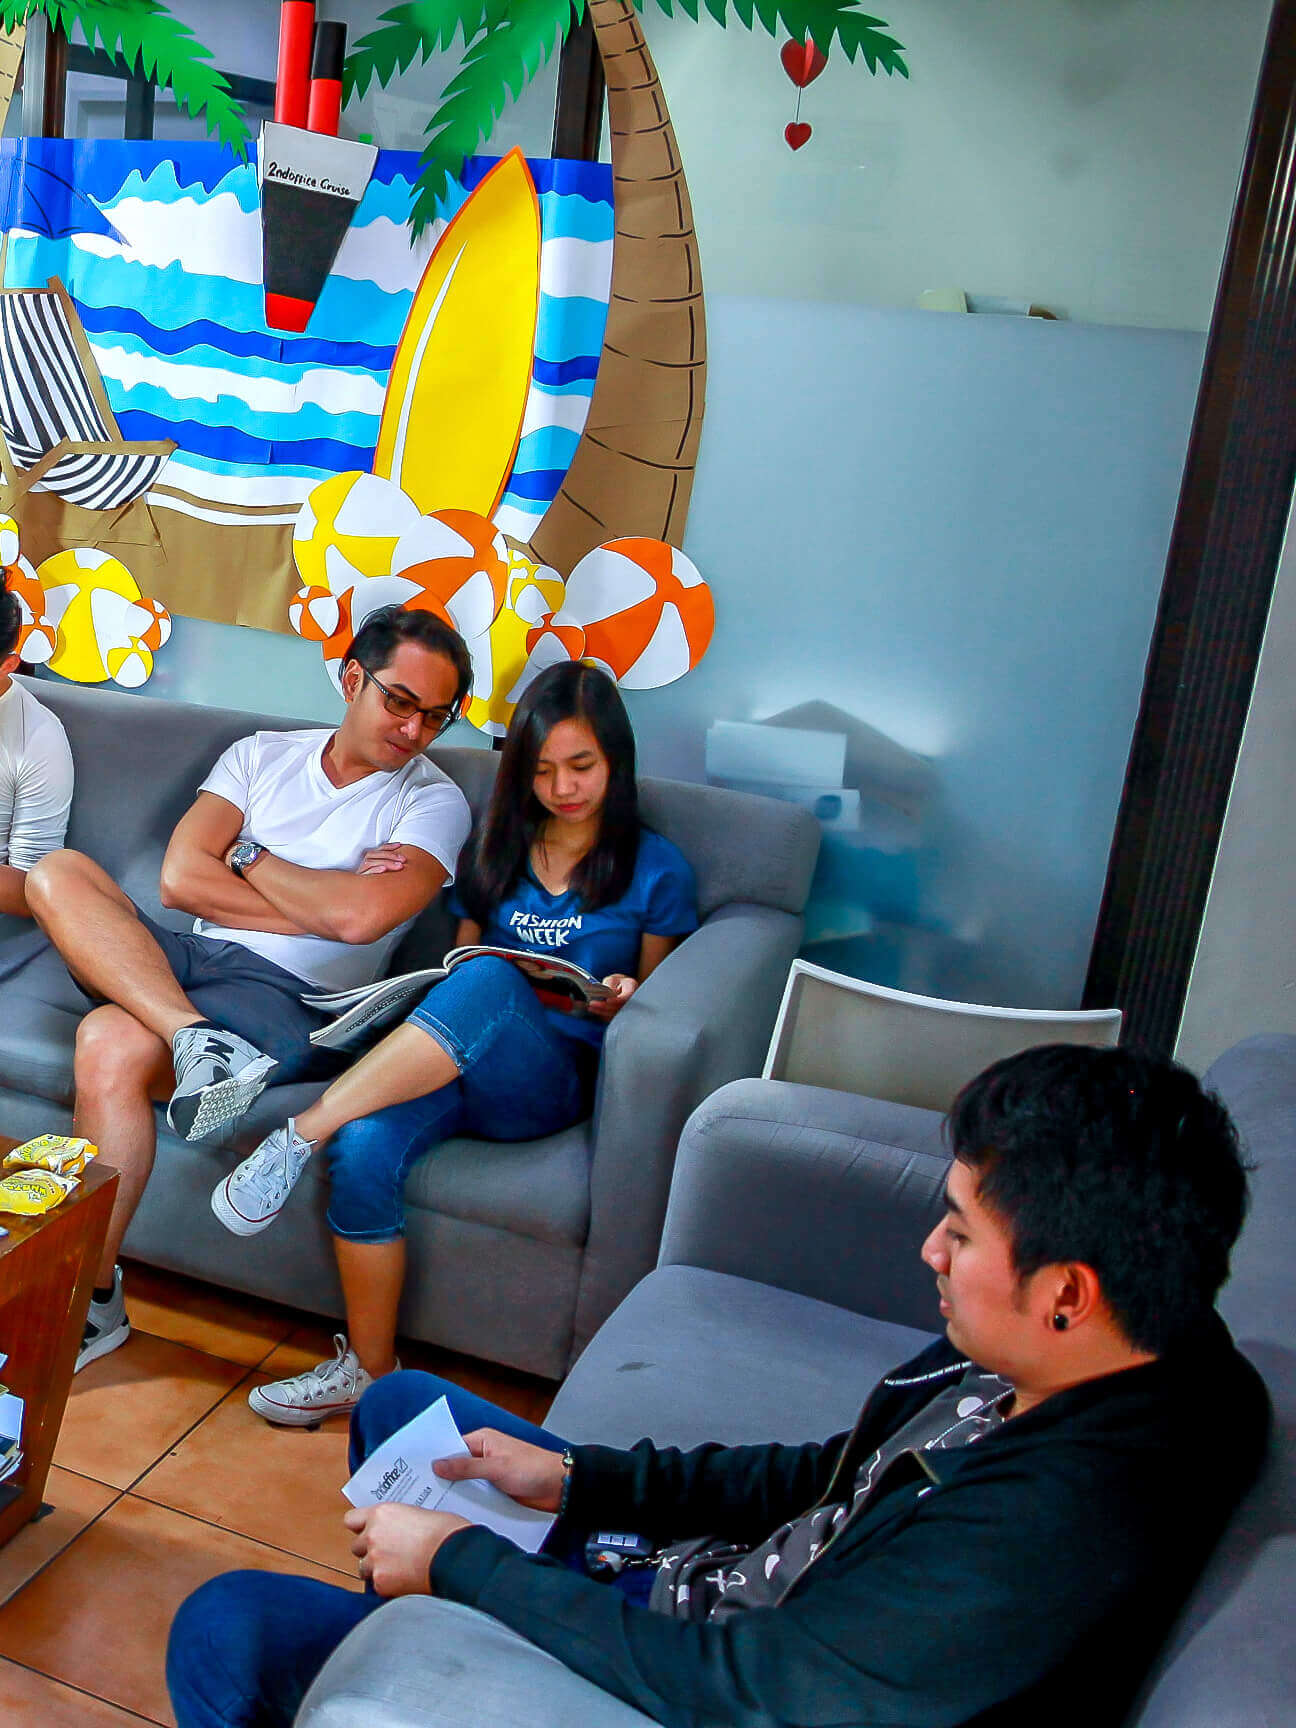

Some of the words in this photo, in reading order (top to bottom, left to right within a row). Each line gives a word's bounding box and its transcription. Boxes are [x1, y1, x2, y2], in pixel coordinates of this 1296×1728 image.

[320, 178, 351, 195] Cruise
[509, 910, 583, 929] FASHION
[516, 926, 570, 947] WEEK
